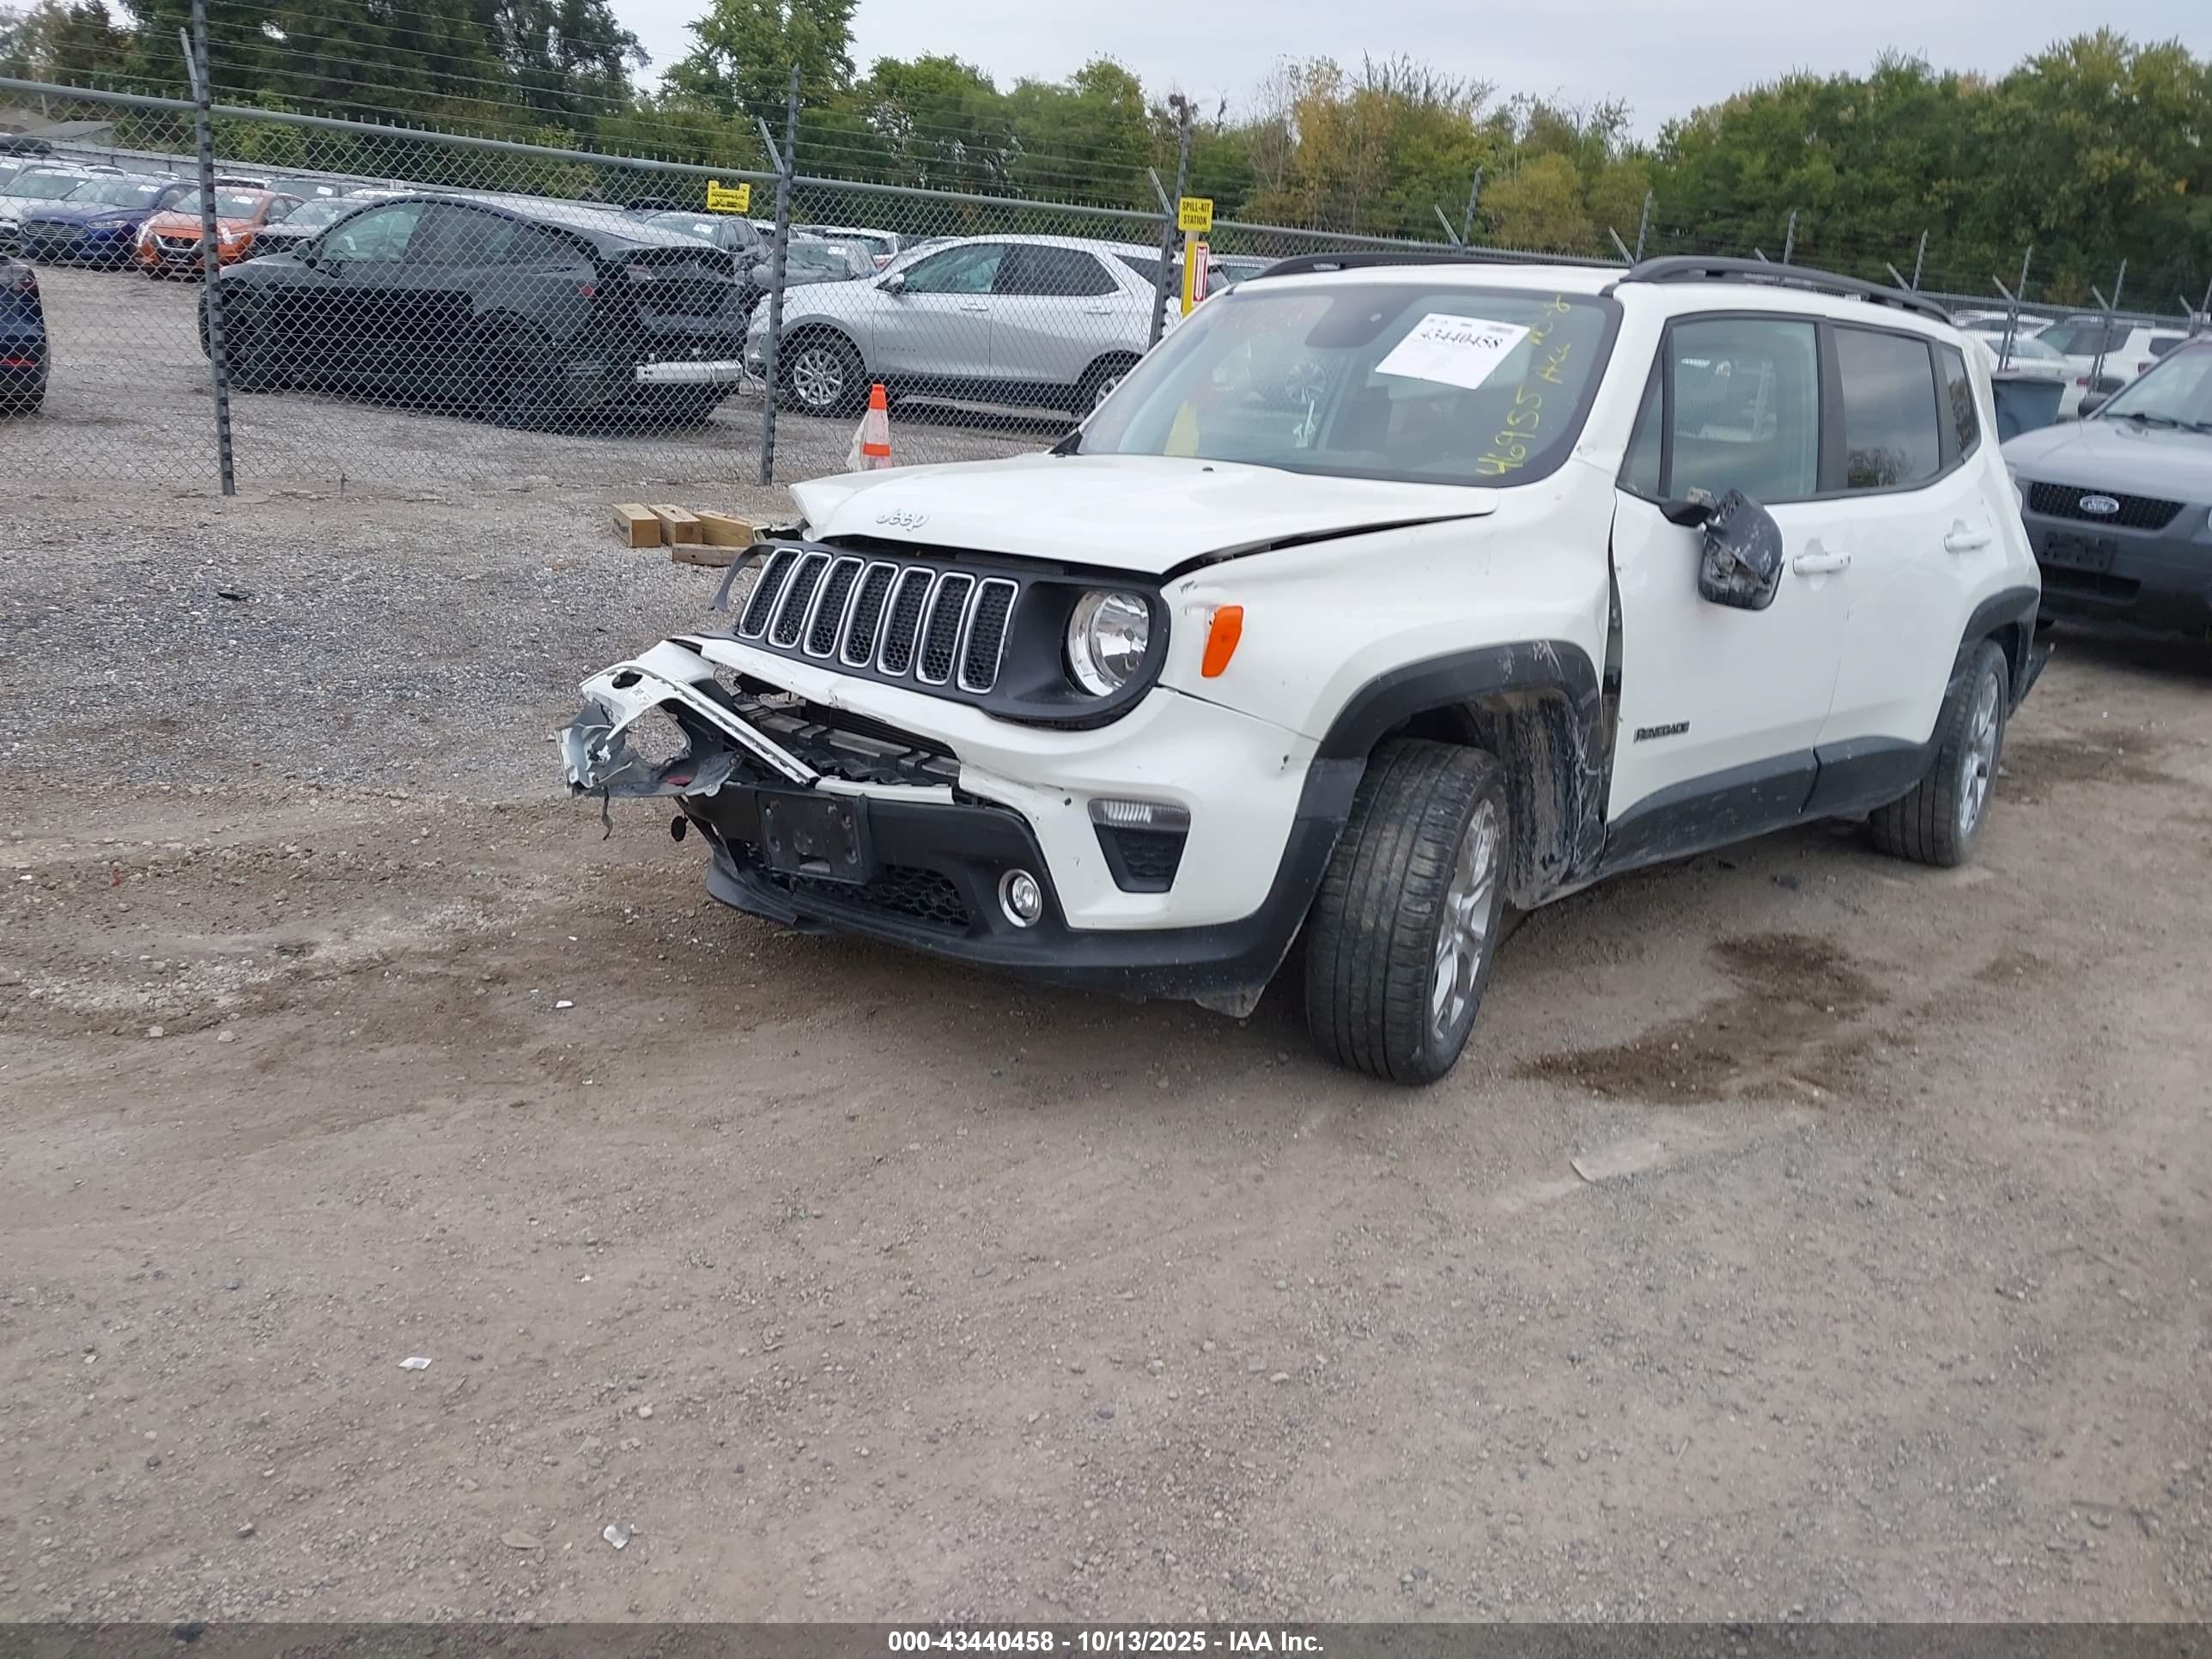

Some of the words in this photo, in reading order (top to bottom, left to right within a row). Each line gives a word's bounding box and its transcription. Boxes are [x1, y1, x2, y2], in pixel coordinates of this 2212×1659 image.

[1182, 201, 1210, 212] SPILL-KIT
[1183, 215, 1207, 225] STATION
[875, 508, 930, 532] Jeep
